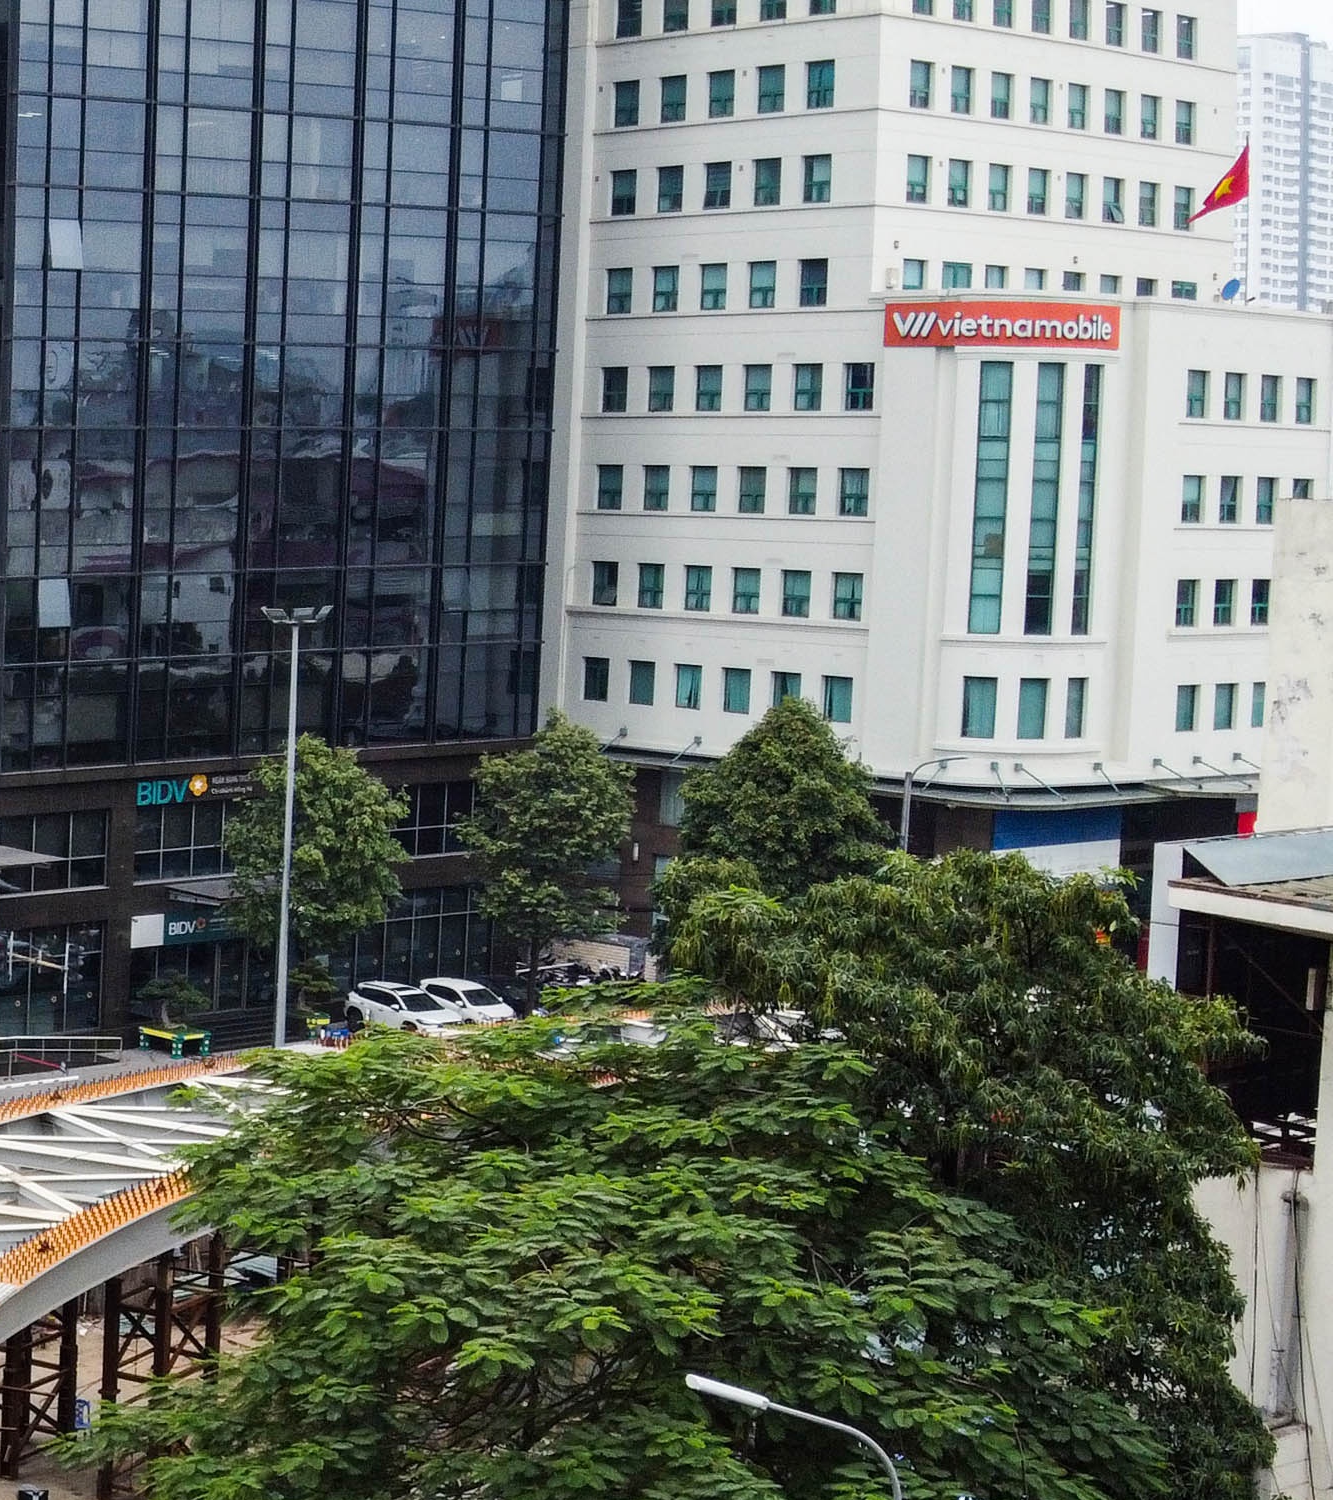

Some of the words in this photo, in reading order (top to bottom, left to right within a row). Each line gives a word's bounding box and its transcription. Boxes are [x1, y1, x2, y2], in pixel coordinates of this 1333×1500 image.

[937, 311, 1112, 341] vietnamobile
[136, 779, 190, 806] BIDV
[168, 920, 197, 936] BIDV
